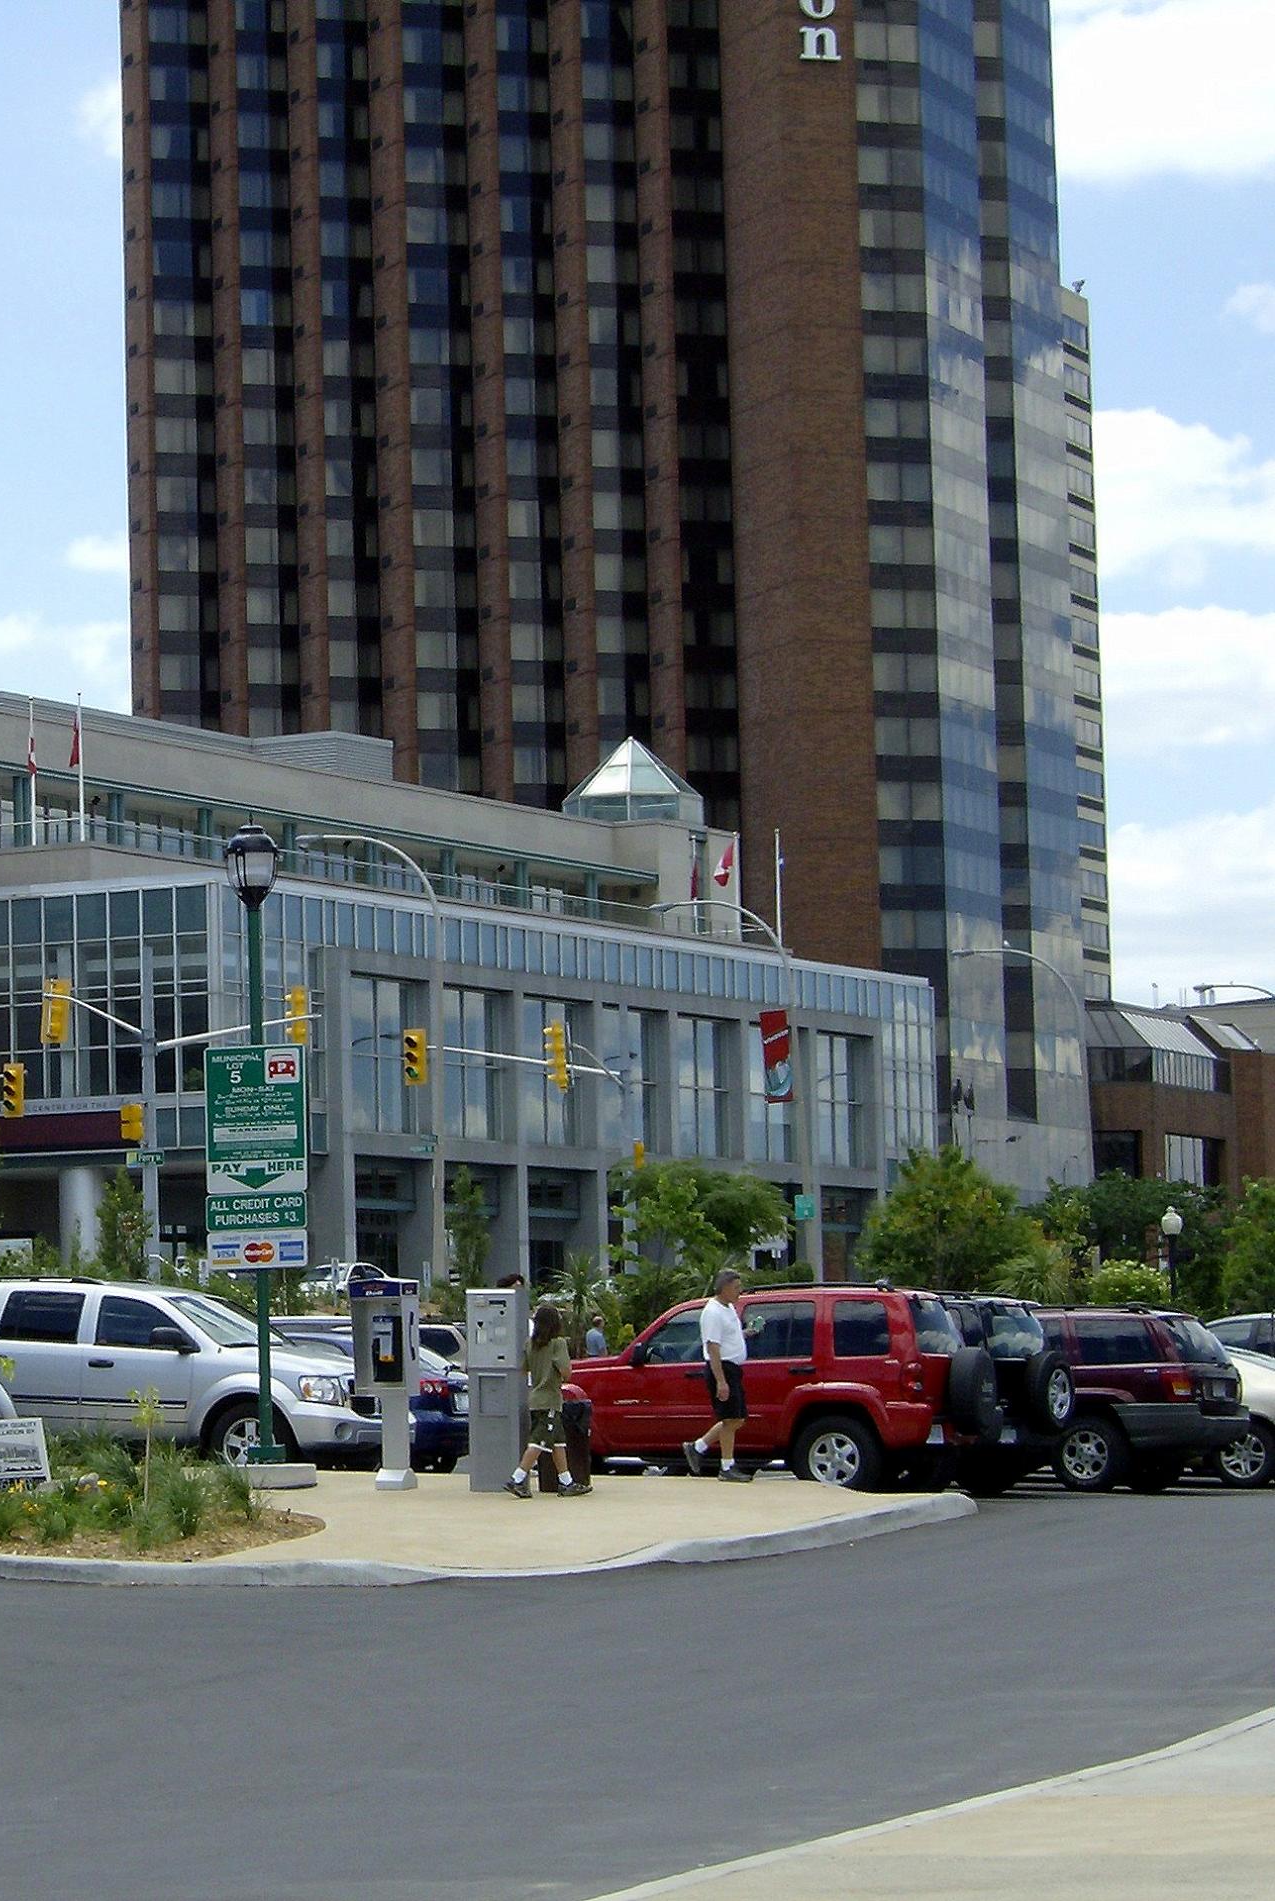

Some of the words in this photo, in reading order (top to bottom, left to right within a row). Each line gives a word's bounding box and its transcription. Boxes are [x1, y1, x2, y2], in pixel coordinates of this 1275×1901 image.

[211, 1053, 262, 1063] MUNICIPAL
[226, 1062, 244, 1070] LOT
[277, 1062, 287, 1073] P
[230, 1071, 242, 1084] 5
[211, 1163, 242, 1174] PAY
[268, 1160, 304, 1172] HERE
[210, 1200, 230, 1212] ALL
[232, 1197, 270, 1211] CREDIT
[274, 1196, 303, 1208] CARD
[215, 1212, 280, 1226] PURCHASES
[217, 1250, 236, 1258] VISA
